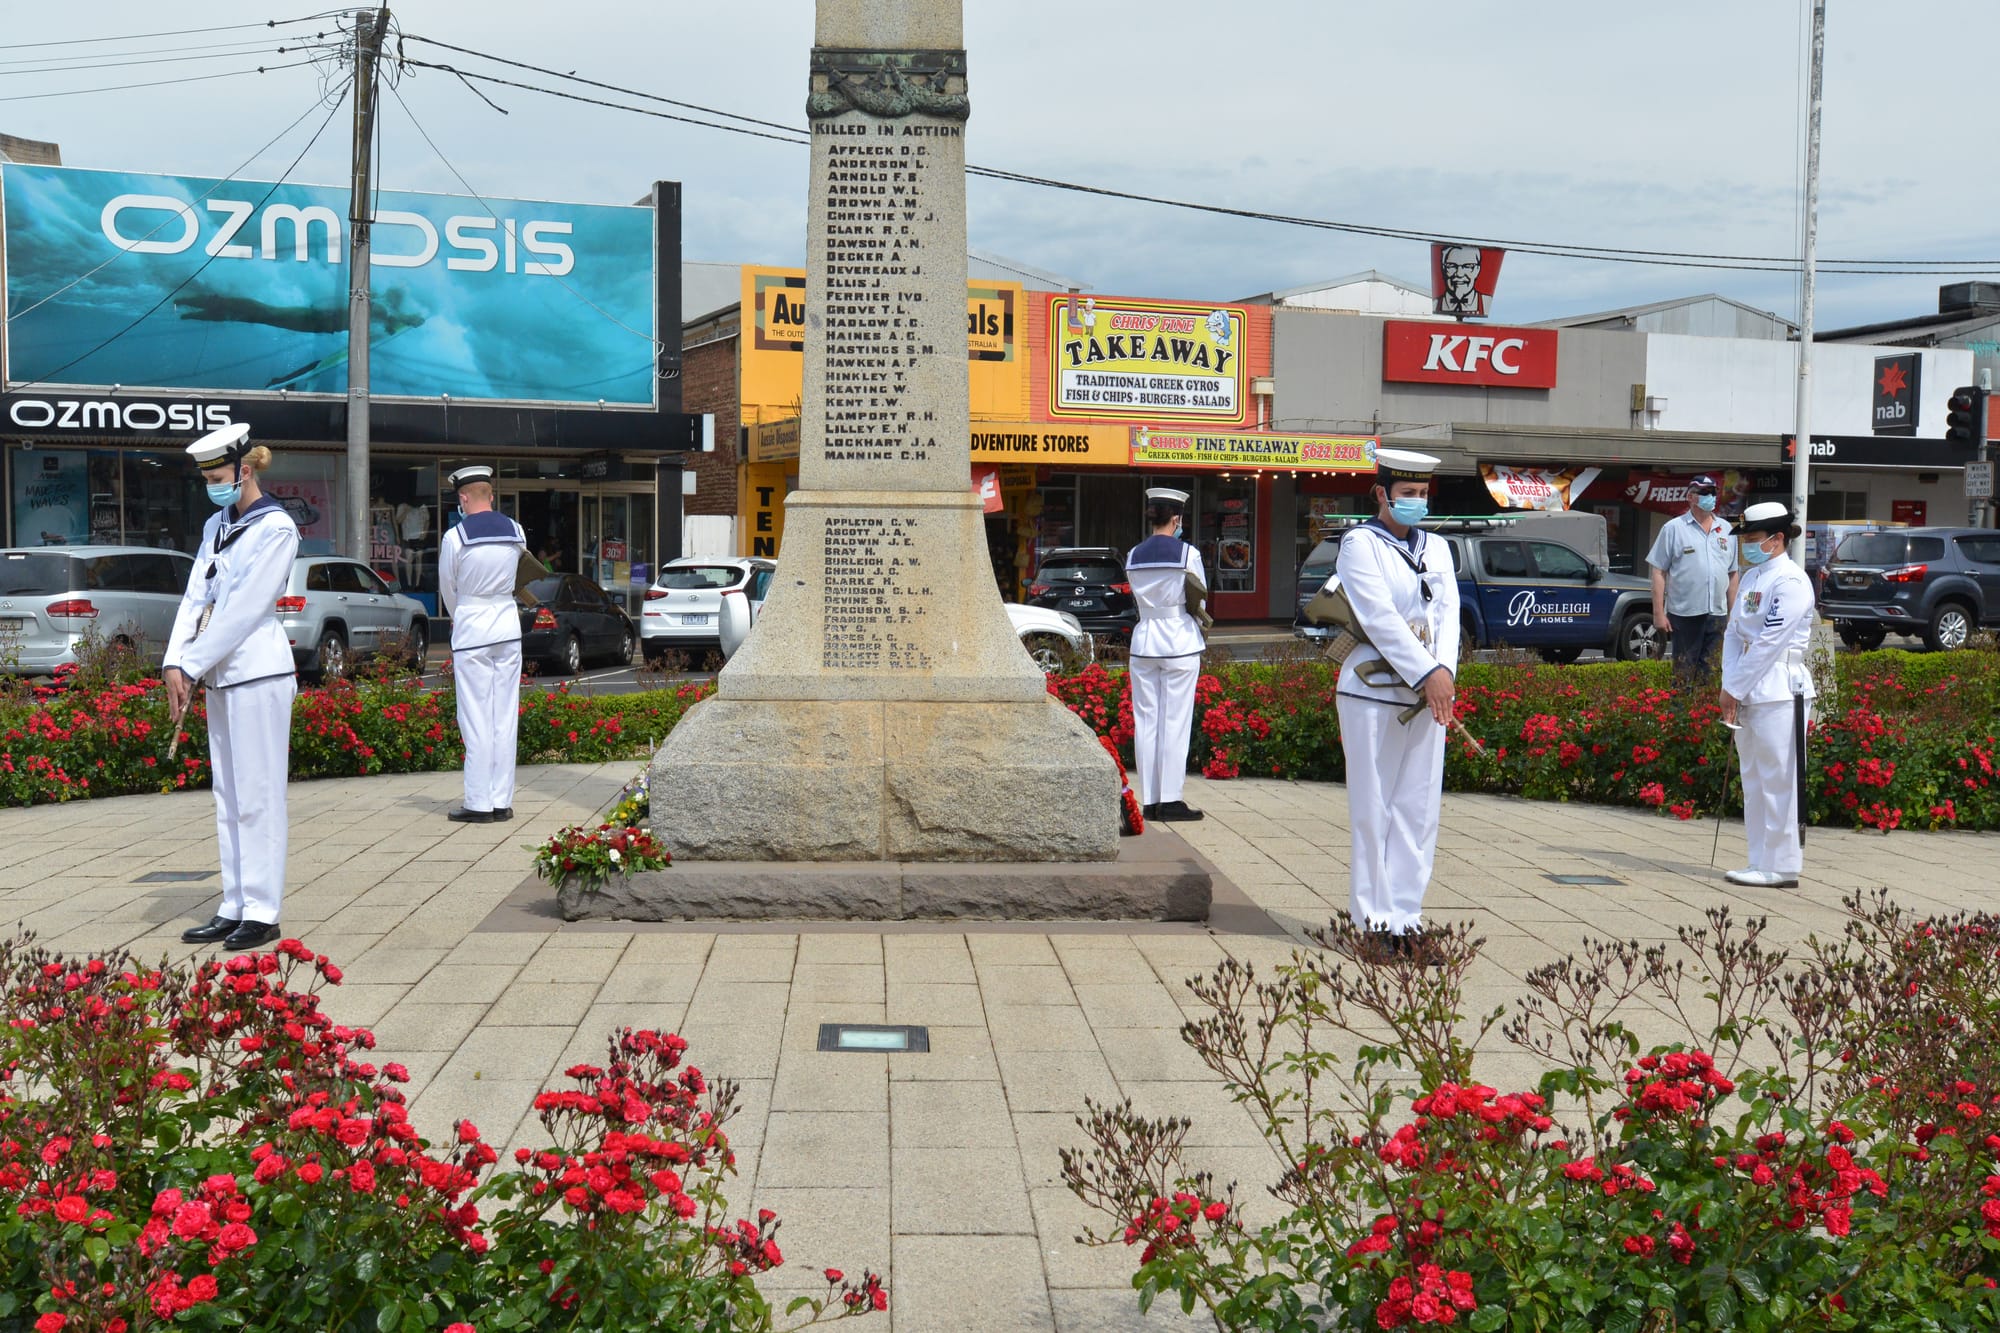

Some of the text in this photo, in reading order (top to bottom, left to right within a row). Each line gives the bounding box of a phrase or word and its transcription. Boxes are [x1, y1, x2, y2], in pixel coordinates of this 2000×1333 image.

[815, 123, 960, 137] KILLED IN ACTION
[828, 145, 893, 156] AFFLECK
[828, 158, 929, 169] ANDERSON L.
[828, 172, 888, 182] ARNOLD
[828, 185, 924, 195] ARNOLD W.L.
[827, 198, 922, 208] BROWN A.M.
[827, 211, 895, 221] CHRISTIE
[827, 225, 874, 235] CLARK
[827, 239, 926, 249] DAWSON A.N.
[827, 252, 906, 262] DECKER A.
[827, 265, 926, 275] DEVEREAUX J.
[827, 278, 886, 288] ELLIS J.
[826, 291, 890, 301] FERRIER
[826, 305, 911, 315] GROVE T.L.
[826, 318, 889, 328] HADLOW
[1111, 314, 1196, 334] CHRIS' FINE
[826, 331, 881, 341] HAINES
[826, 345, 899, 354] HASTINGS
[1421, 333, 1525, 375] KFC
[826, 358, 921, 368] HAWKEN A.F.
[825, 371, 908, 381] HINKLEY T.
[1076, 374, 1220, 392] TRADITIONAL GREEK GYROS
[825, 384, 911, 394] KEATING W.
[825, 398, 903, 407] KENT E.W.
[1066, 388, 1231, 408] FISH & CHIPS BURGERS SALADS
[1876, 401, 1906, 420] nab
[825, 411, 938, 421] LAMPORT R.H.
[825, 424, 876, 434] LILLEY
[825, 437, 902, 447] LOCKHART
[1042, 434, 1089, 453] STORES
[1150, 436, 1363, 461] CHRIS' FINE TAKEAWAY 5622 2201
[1809, 440, 1836, 456] nab
[824, 450, 893, 460] MANNING
[1148, 451, 1171, 460] GREEK
[1171, 452, 1194, 460] GYROS
[1197, 453, 1212, 462] FISH
[1219, 454, 1239, 463] CHIPS
[1242, 454, 1271, 463] BURGERS
[1274, 455, 1299, 464] SALADS
[1508, 485, 1552, 497] NUGGETS
[825, 517, 883, 526] APPLETON
[825, 527, 871, 536] ASCOTT
[824, 537, 879, 546] BALDWIN
[824, 547, 857, 556] BRAY
[824, 557, 883, 566] BURLEIGH
[824, 576, 874, 585] CLARKE
[824, 586, 885, 595] DAVIDSON
[824, 596, 868, 605] DEVINE
[824, 606, 891, 614] FERGUSON
[1540, 616, 1574, 624] HOMES
